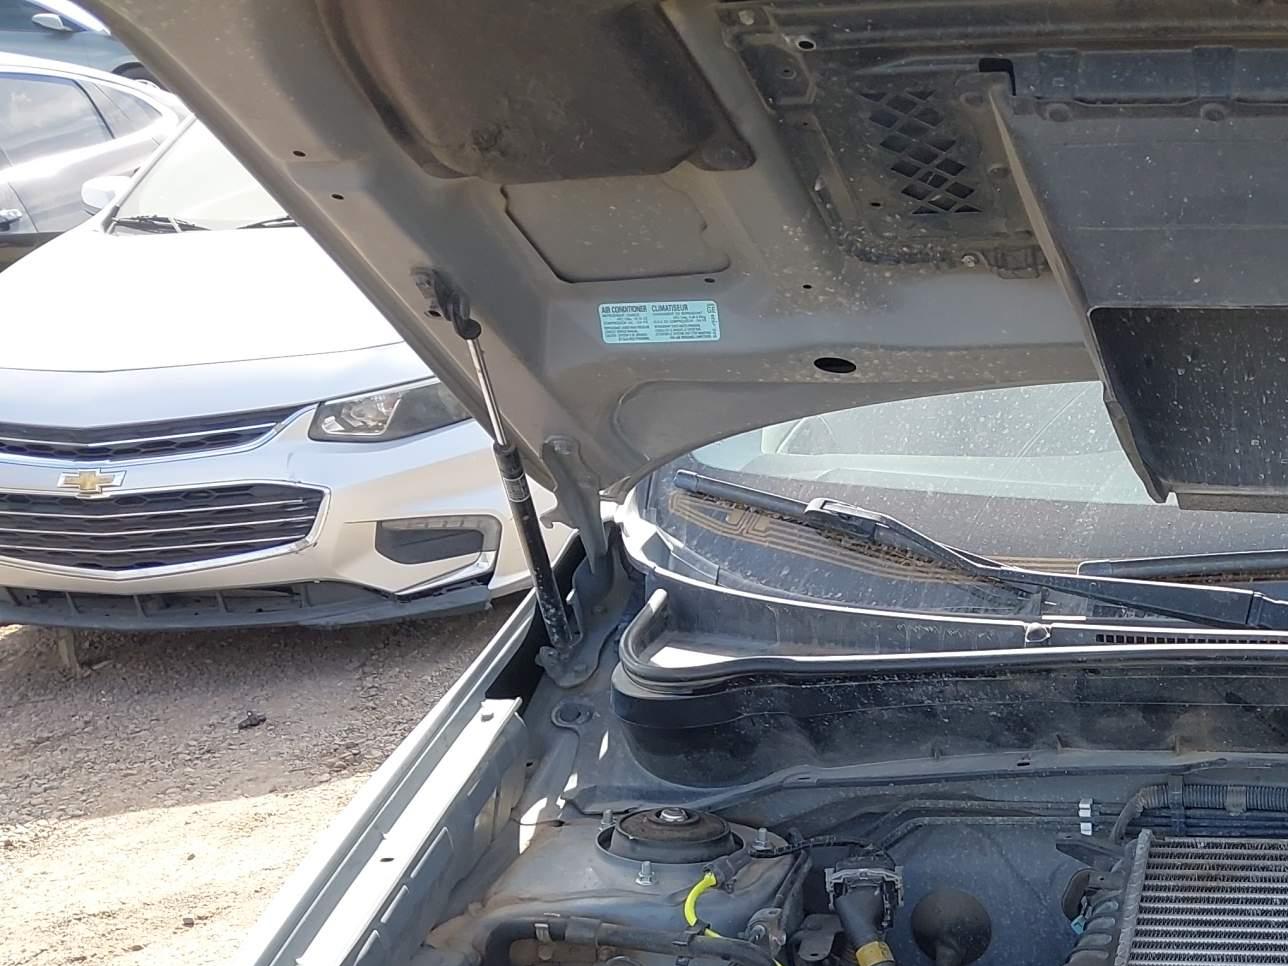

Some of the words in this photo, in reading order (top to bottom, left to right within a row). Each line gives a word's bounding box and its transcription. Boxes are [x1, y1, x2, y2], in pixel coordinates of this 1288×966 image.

[601, 305, 611, 313] AIR
[612, 305, 647, 313] CONDITIONER
[652, 304, 688, 312] CLIMATISEUR
